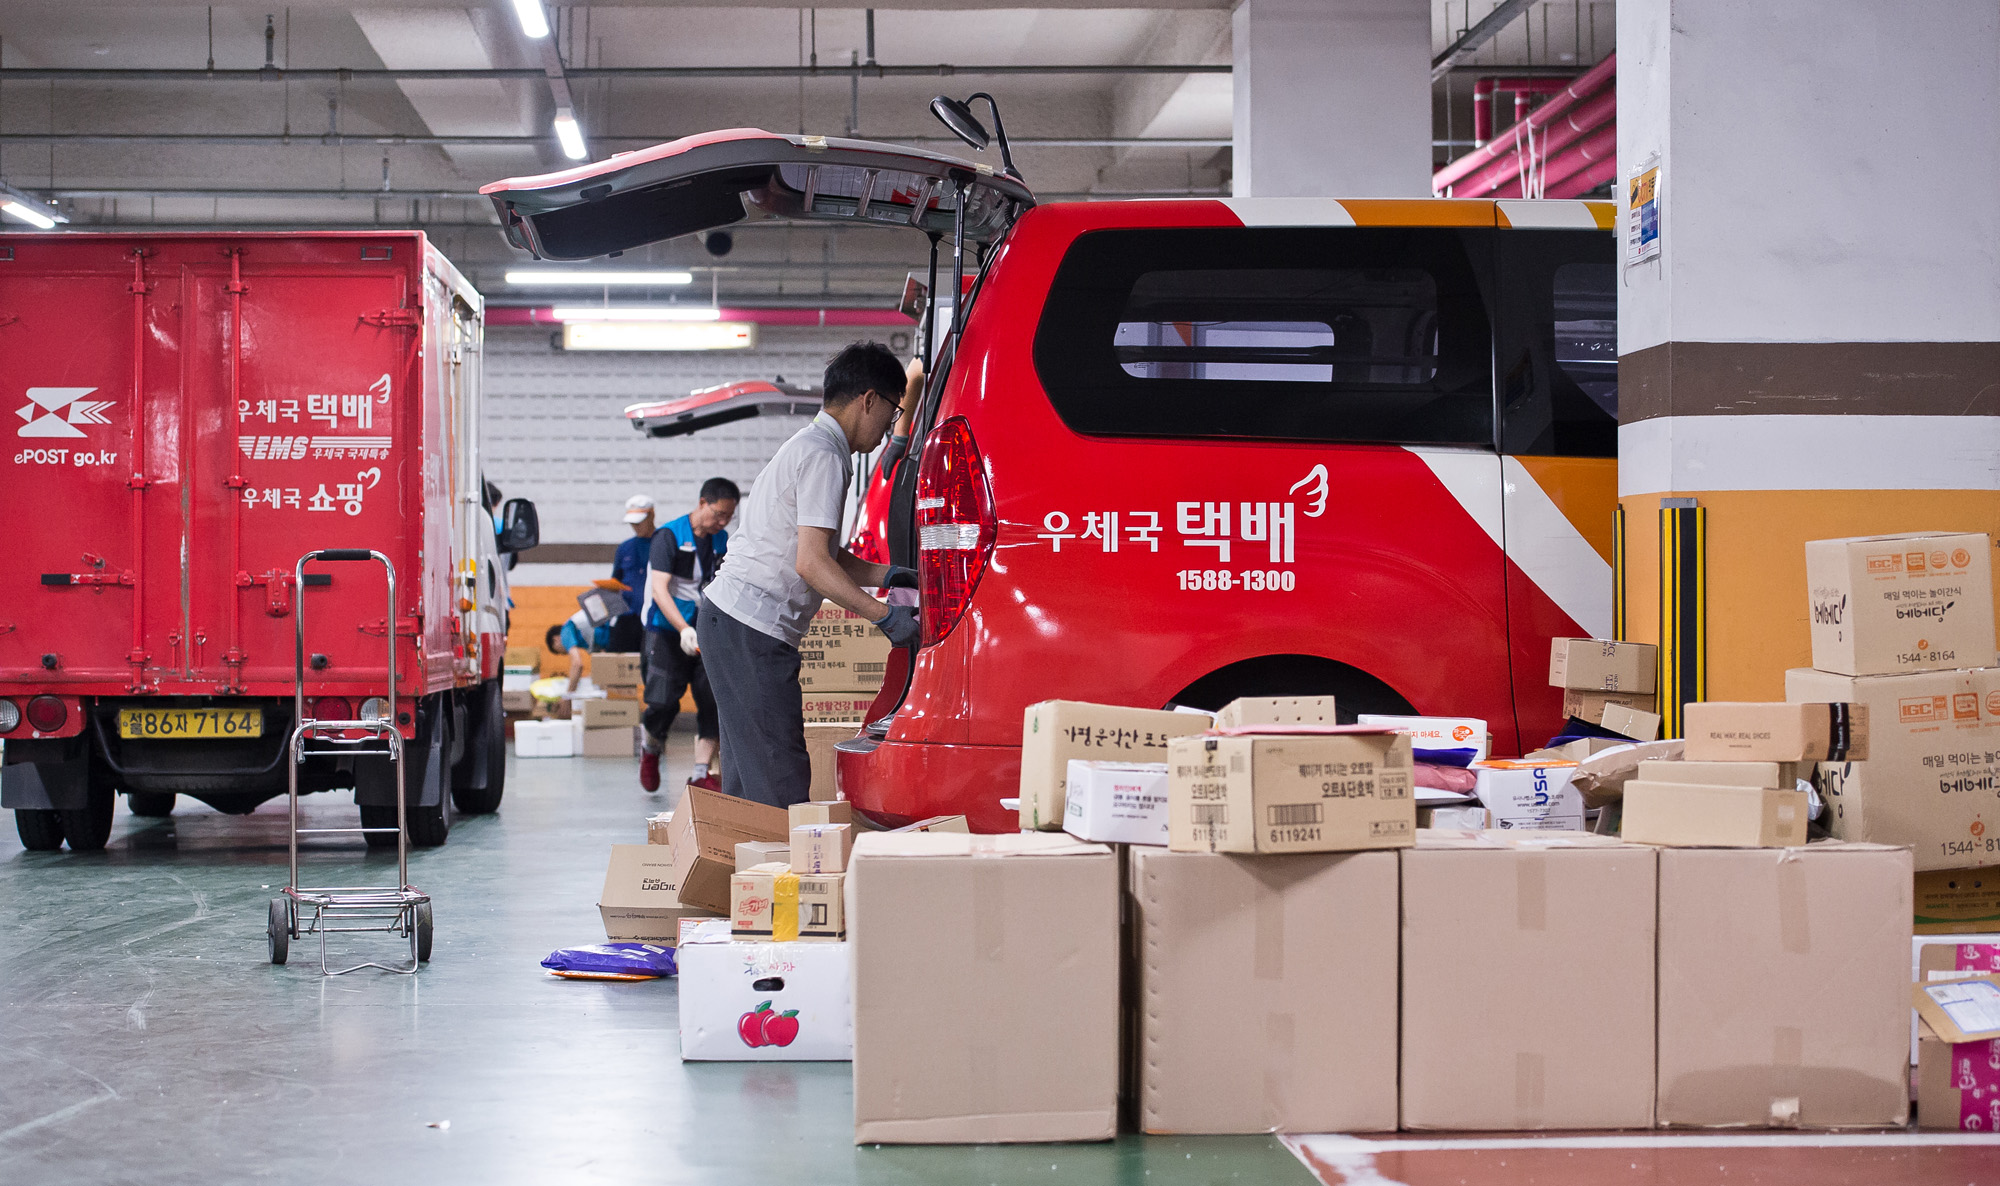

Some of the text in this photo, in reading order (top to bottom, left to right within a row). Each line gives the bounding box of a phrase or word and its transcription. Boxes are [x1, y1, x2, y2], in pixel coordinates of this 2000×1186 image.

[238, 394, 372, 429] 우체국 택배
[253, 436, 309, 460] EMS
[313, 449, 344, 460] 우체국
[14, 449, 117, 467] ePOST go.kr
[241, 484, 363, 516] 우체국 쇼핑
[1037, 502, 1295, 563] 우체국 택배
[1177, 570, 1295, 591] 1588-1300
[1884, 586, 1962, 601] 매일 먹이는 놀이간식
[811, 609, 842, 620] 활건강
[803, 625, 864, 637] 포인트특권
[1897, 654, 1921, 664] 1544
[1929, 651, 1955, 662] 8164
[1902, 703, 1932, 716] IGC
[193, 712, 252, 734] 7164
[1923, 755, 1945, 768] 매일
[1948, 752, 1981, 766] 먹이는
[1270, 828, 1322, 843] 6119241
[1941, 841, 1974, 856] 1544
